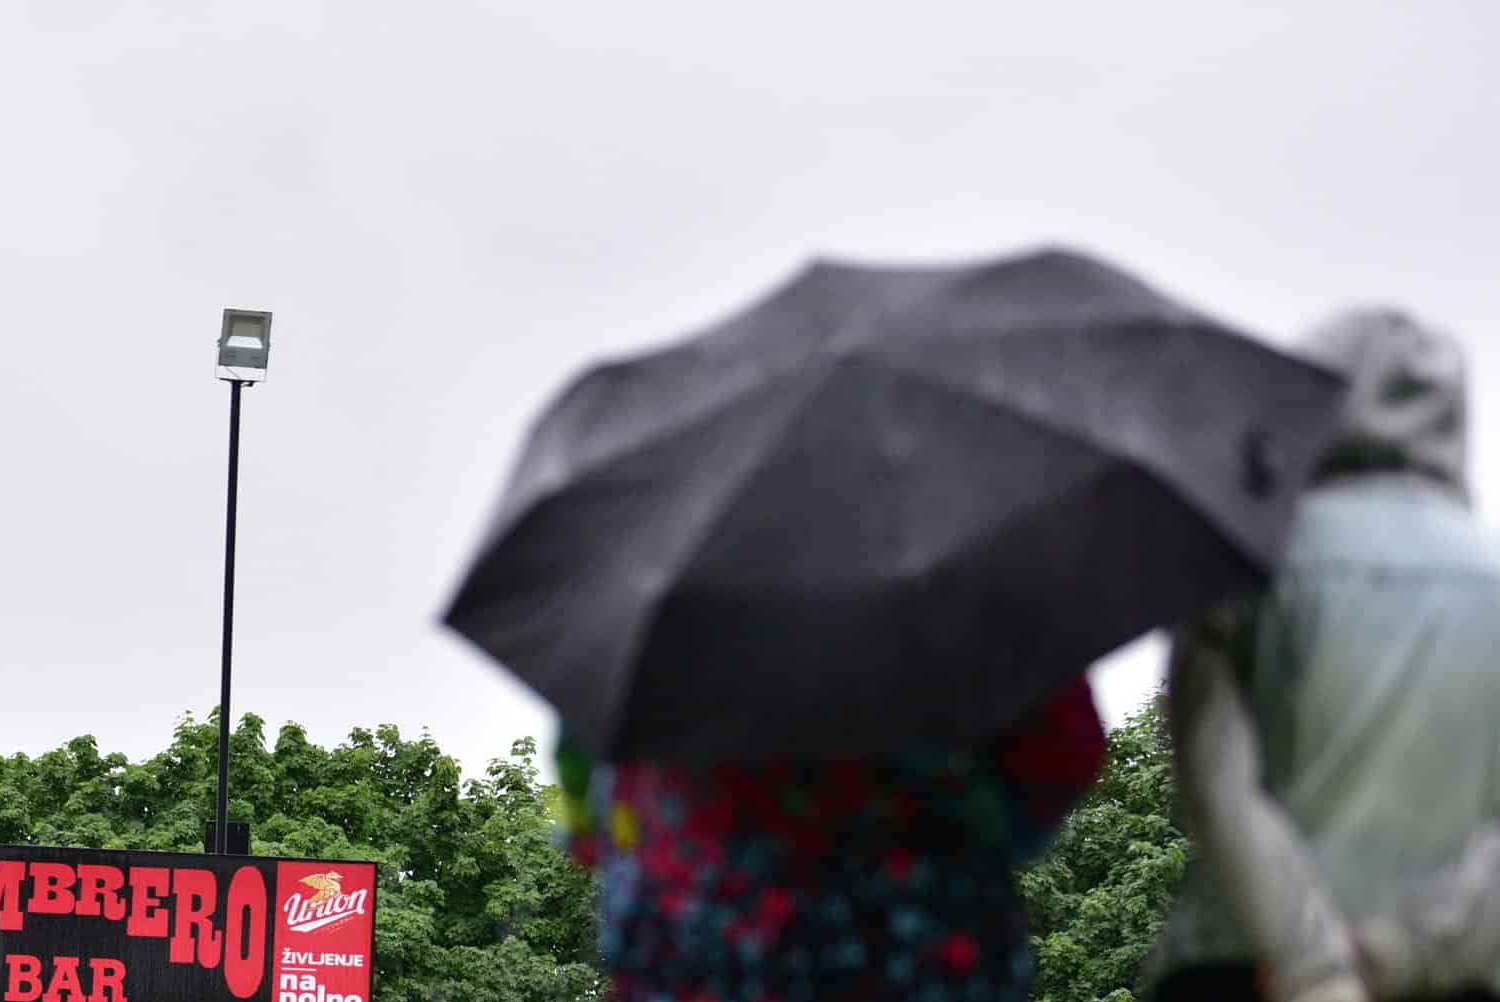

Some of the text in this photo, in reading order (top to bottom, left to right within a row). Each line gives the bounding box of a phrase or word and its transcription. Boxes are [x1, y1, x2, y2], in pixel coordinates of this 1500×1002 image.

[283, 888, 367, 926] Union
[280, 947, 365, 967] ŽIVLJENJE
[279, 973, 317, 991] na
